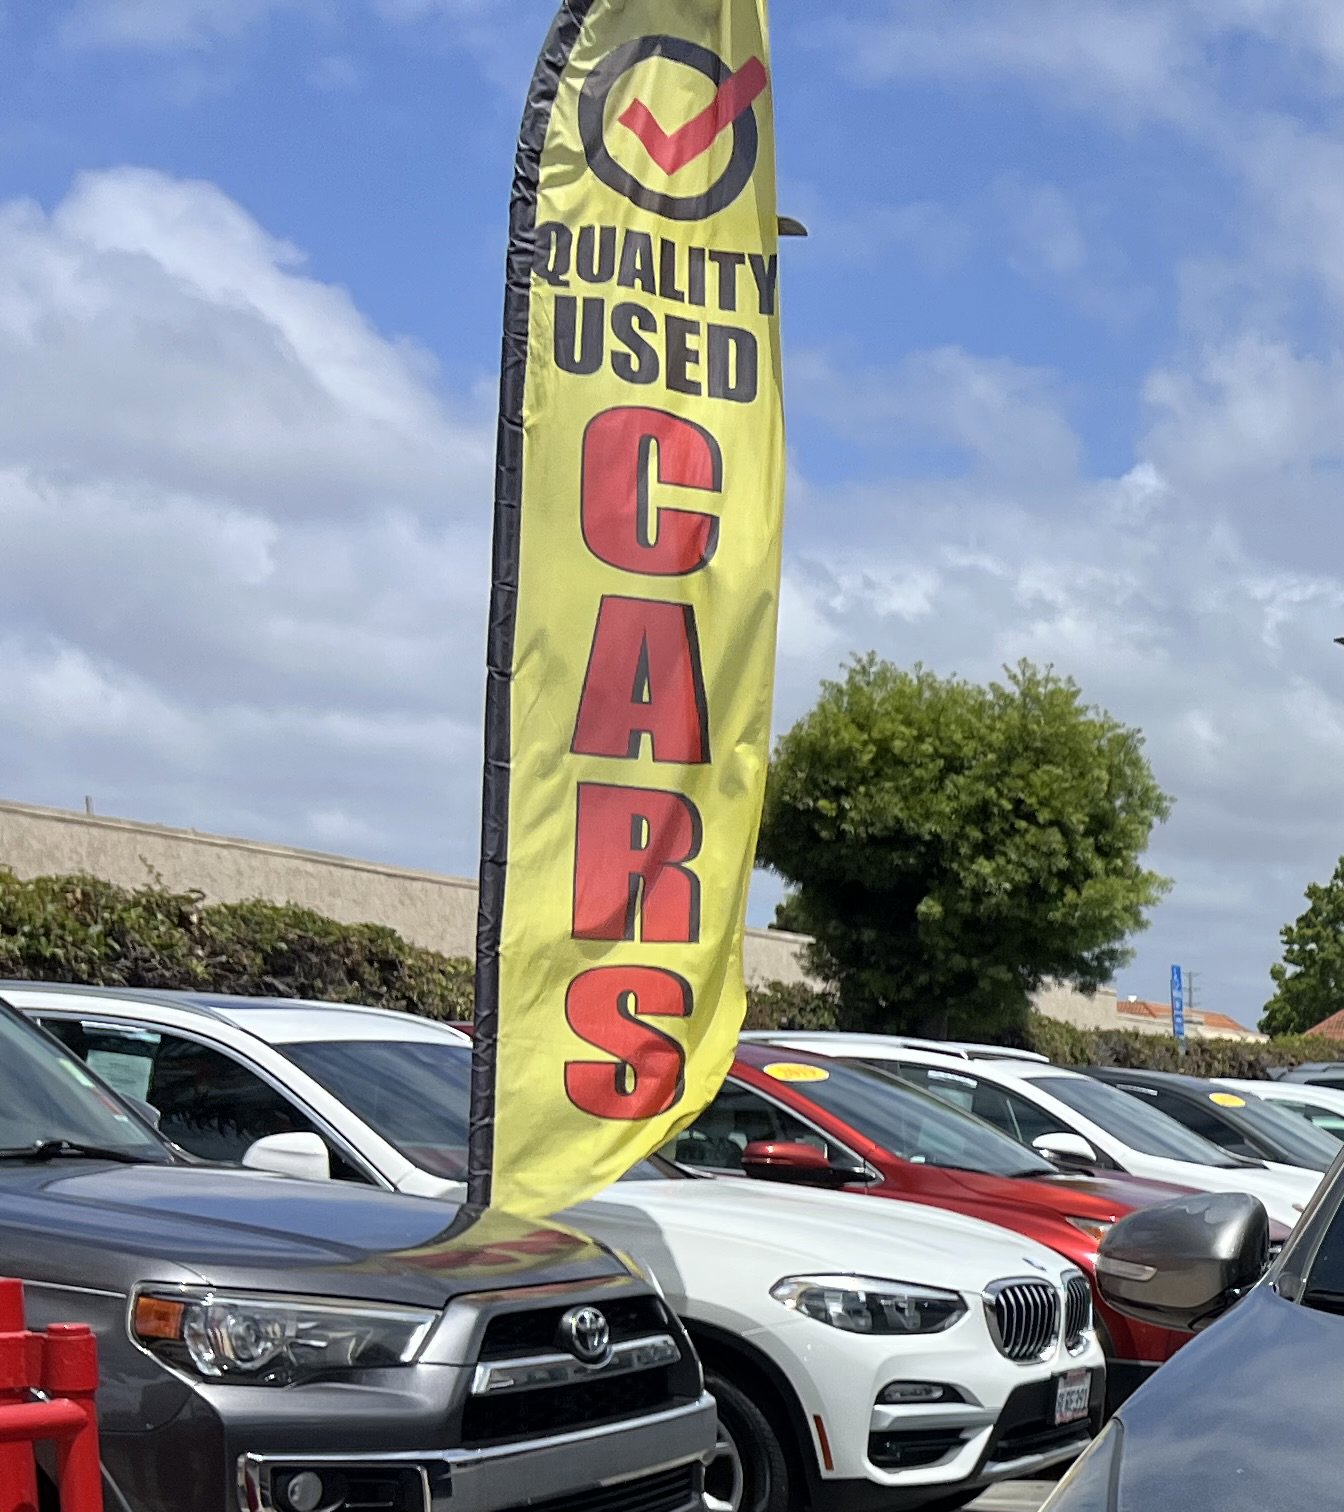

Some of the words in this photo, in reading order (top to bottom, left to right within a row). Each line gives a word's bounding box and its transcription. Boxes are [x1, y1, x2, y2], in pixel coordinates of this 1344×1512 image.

[532, 221, 778, 316] QUALITY
[553, 295, 758, 404] USED
[563, 405, 723, 1120] CARS
